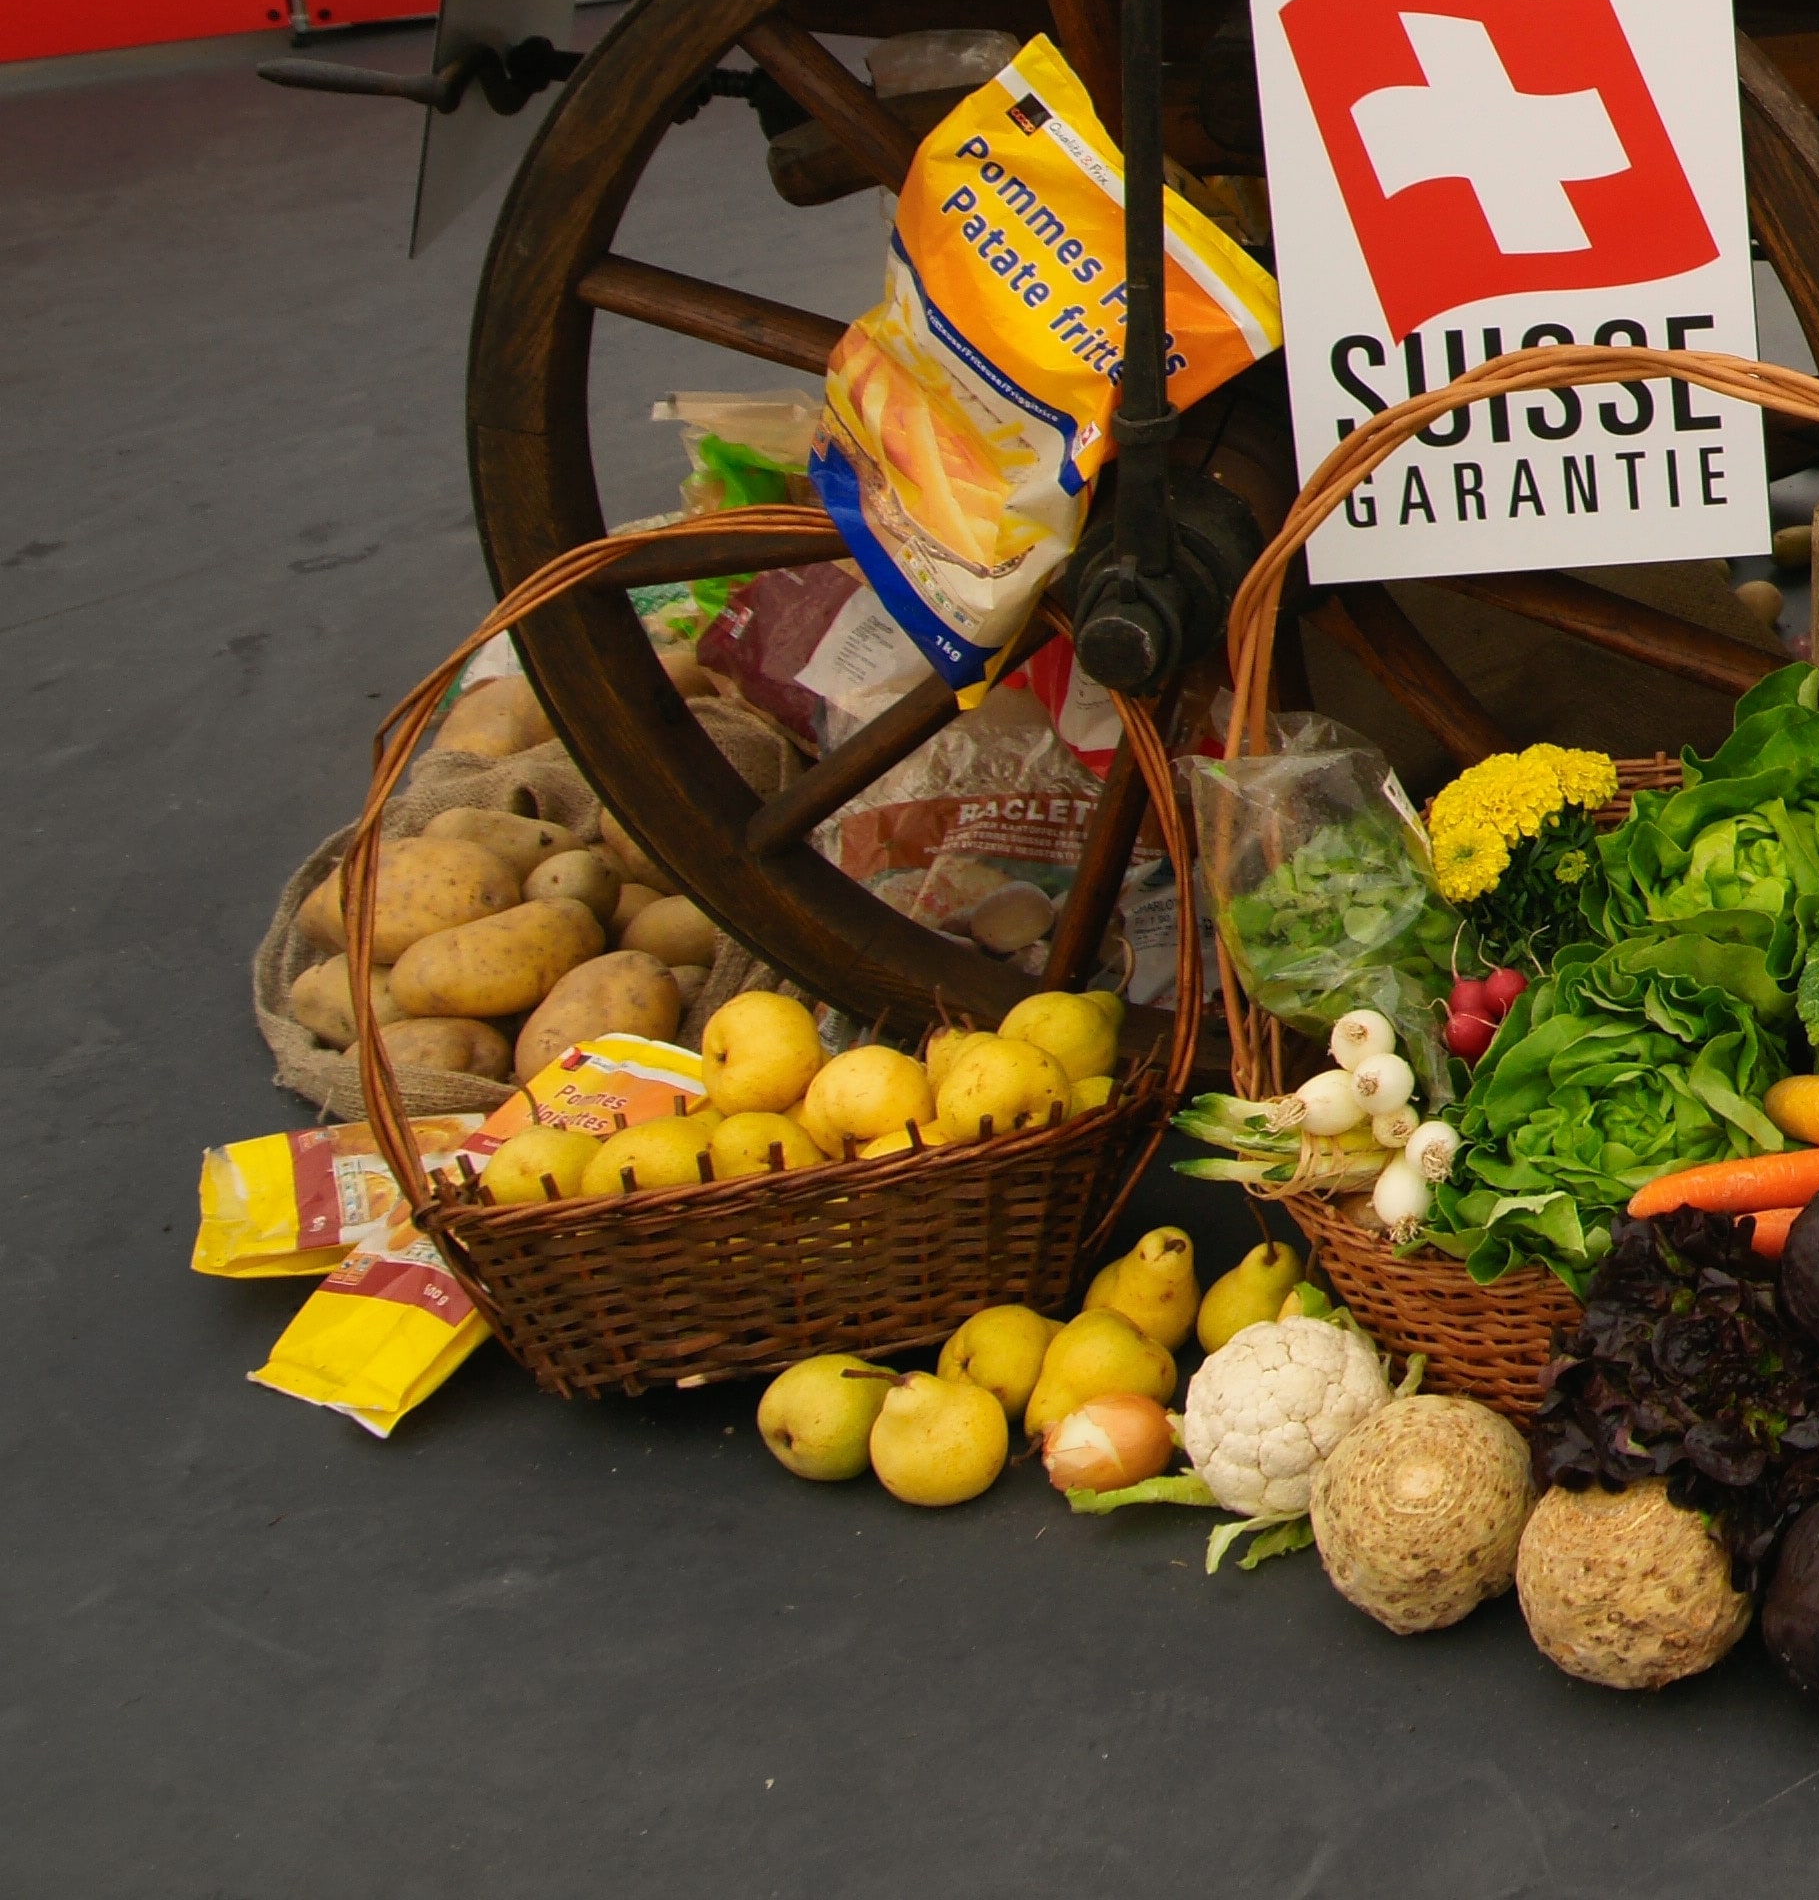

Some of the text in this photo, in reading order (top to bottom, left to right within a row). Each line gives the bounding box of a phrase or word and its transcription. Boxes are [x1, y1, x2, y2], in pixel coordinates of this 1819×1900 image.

[1049, 121, 1082, 158] Qualité
[1089, 163, 1107, 186] Prix
[941, 185, 1051, 308] Patate
[954, 134, 1104, 284] Pommes
[1330, 315, 1722, 446] SUISSE
[1345, 447, 1728, 528] GARANTIE
[958, 798, 1098, 823] RACLET
